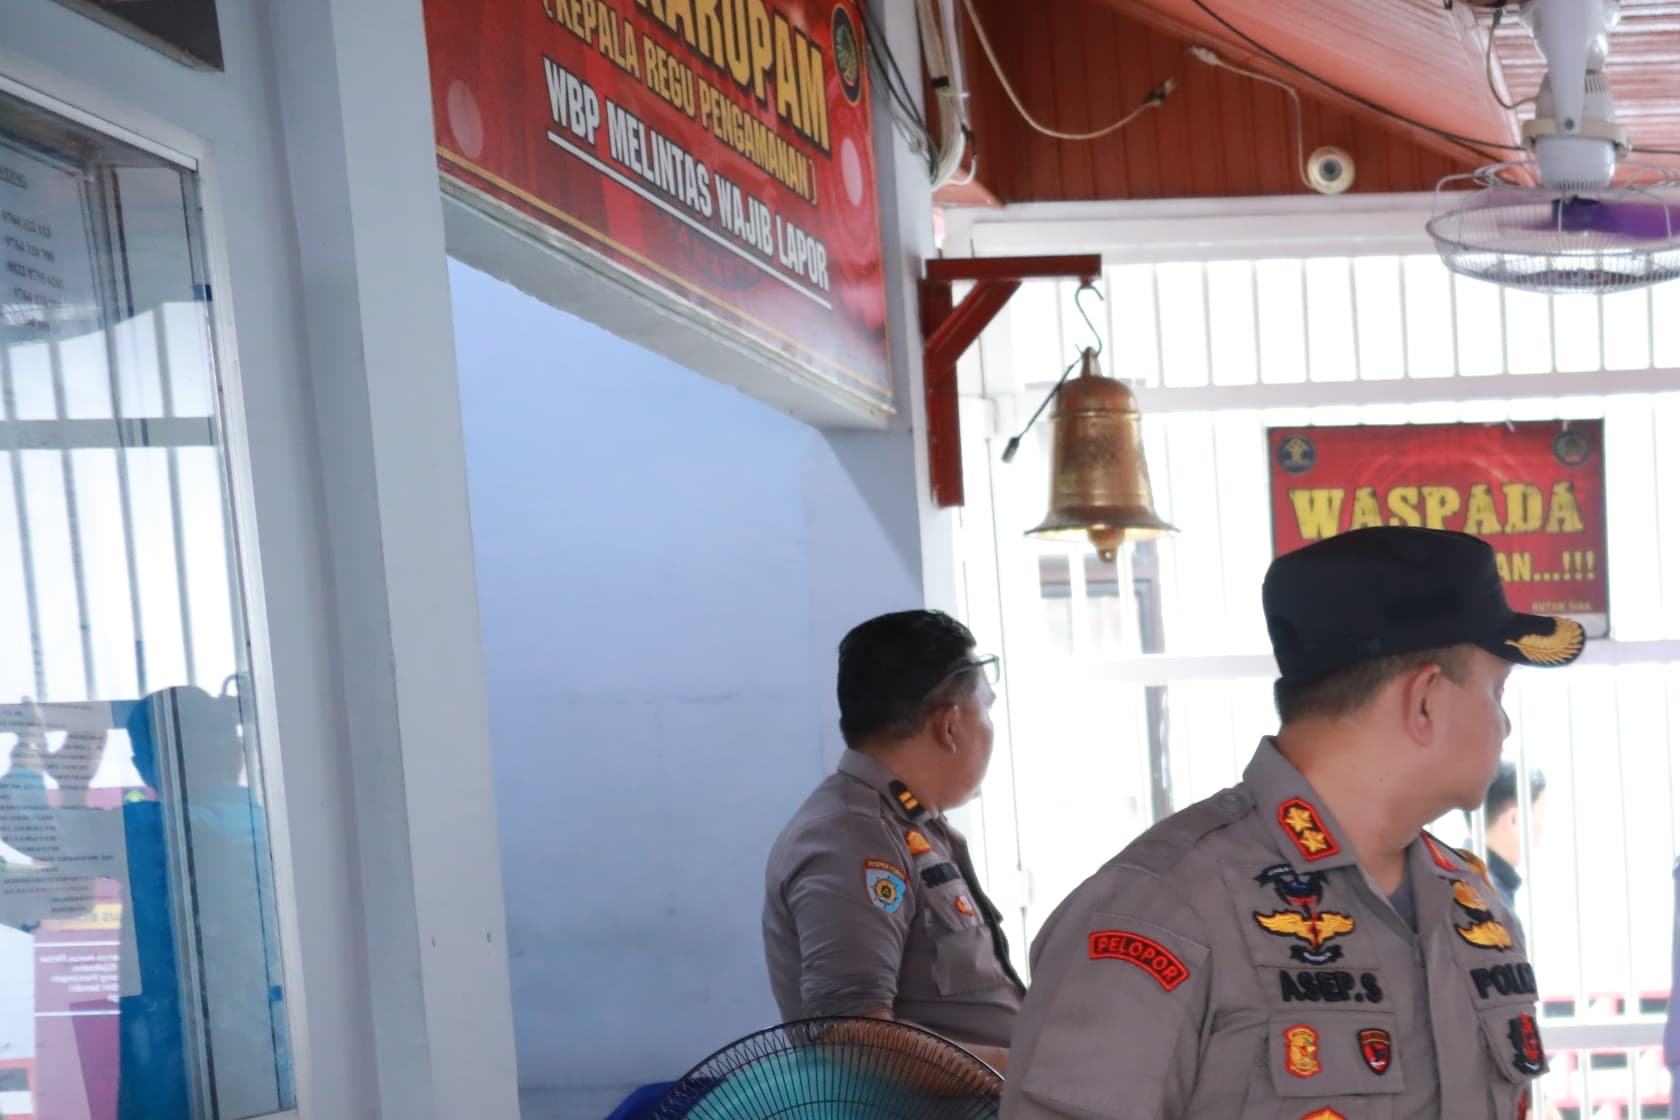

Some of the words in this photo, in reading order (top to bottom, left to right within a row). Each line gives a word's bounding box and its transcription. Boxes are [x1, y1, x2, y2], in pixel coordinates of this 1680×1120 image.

[638, 0, 830, 151] ARUPAM
[643, 33, 696, 118] REGU
[543, 56, 600, 145] WBP
[606, 98, 713, 218] MELINTAS
[714, 172, 774, 257] WAJIB
[776, 215, 830, 292] LAPOR
[1288, 482, 1585, 540] WASPADA
[1097, 936, 1179, 981] PELOPOR
[1279, 969, 1384, 1003] ASEP.S
